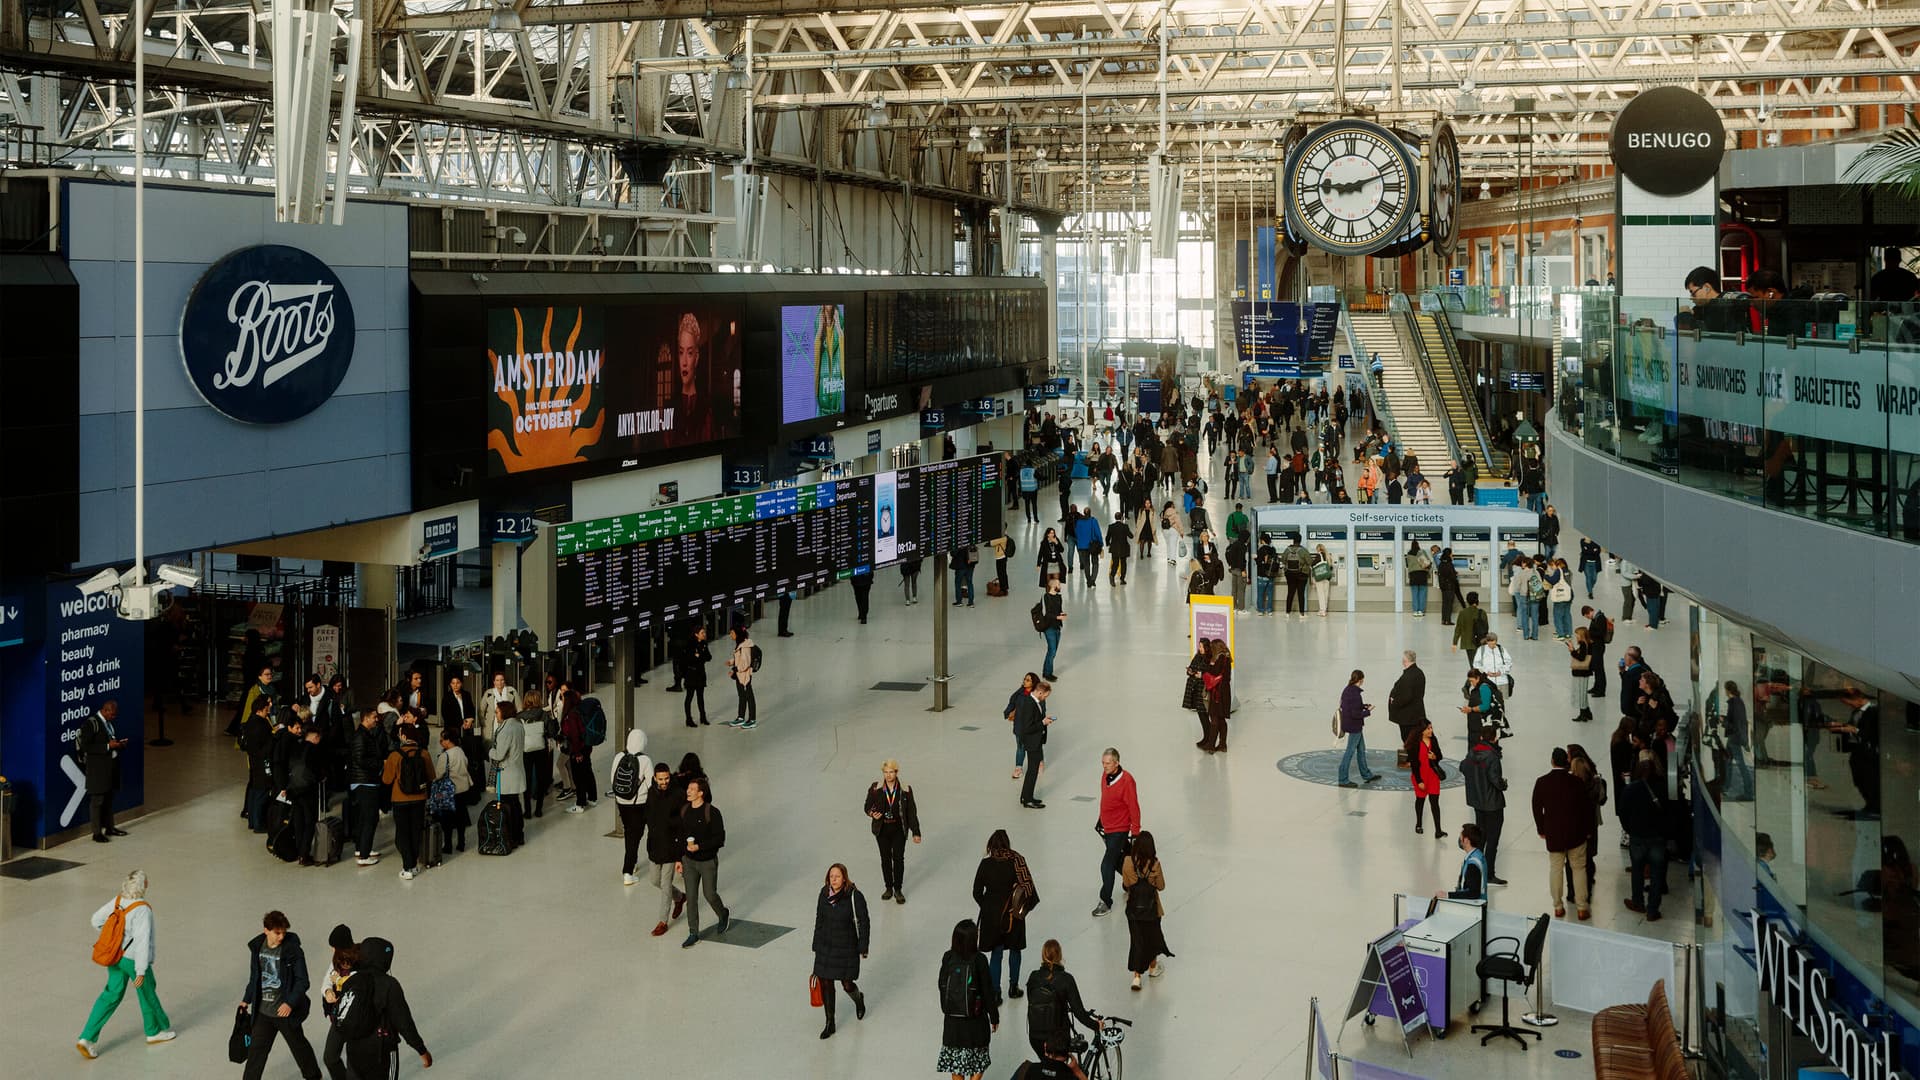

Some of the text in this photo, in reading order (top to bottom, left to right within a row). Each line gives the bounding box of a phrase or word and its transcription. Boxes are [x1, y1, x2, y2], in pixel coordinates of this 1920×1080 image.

[1628, 131, 1711, 149] BENUGO
[212, 280, 335, 390] Boots
[494, 349, 600, 393] AMSTERDAM
[1696, 364, 1746, 395] SANDWICHES
[1028, 389, 1039, 397] 17
[1045, 385, 1055, 393] 18
[1757, 366, 1920, 416] JUICE BAGUETTES WRAP
[525, 398, 572, 411] ONLY IN CINEMAS
[978, 400, 991, 409] 16
[515, 409, 582, 434] OCTOBER 7
[617, 407, 674, 438] ANYA TAYLOR-JOY
[926, 413, 939, 423] 15
[811, 441, 825, 452] 14
[734, 470, 760, 483] 13 13
[836, 482, 850, 490] Further
[836, 492, 856, 502] Departures
[497, 517, 532, 533] 12 12
[1350, 513, 1444, 523] Self-service tickets
[61, 623, 110, 644] pharmacy
[61, 645, 94, 662] beauty
[61, 658, 121, 682] food & drink
[61, 677, 121, 703] baby & child
[61, 704, 90, 724] photo
[1750, 908, 1900, 1080] WHSmith
